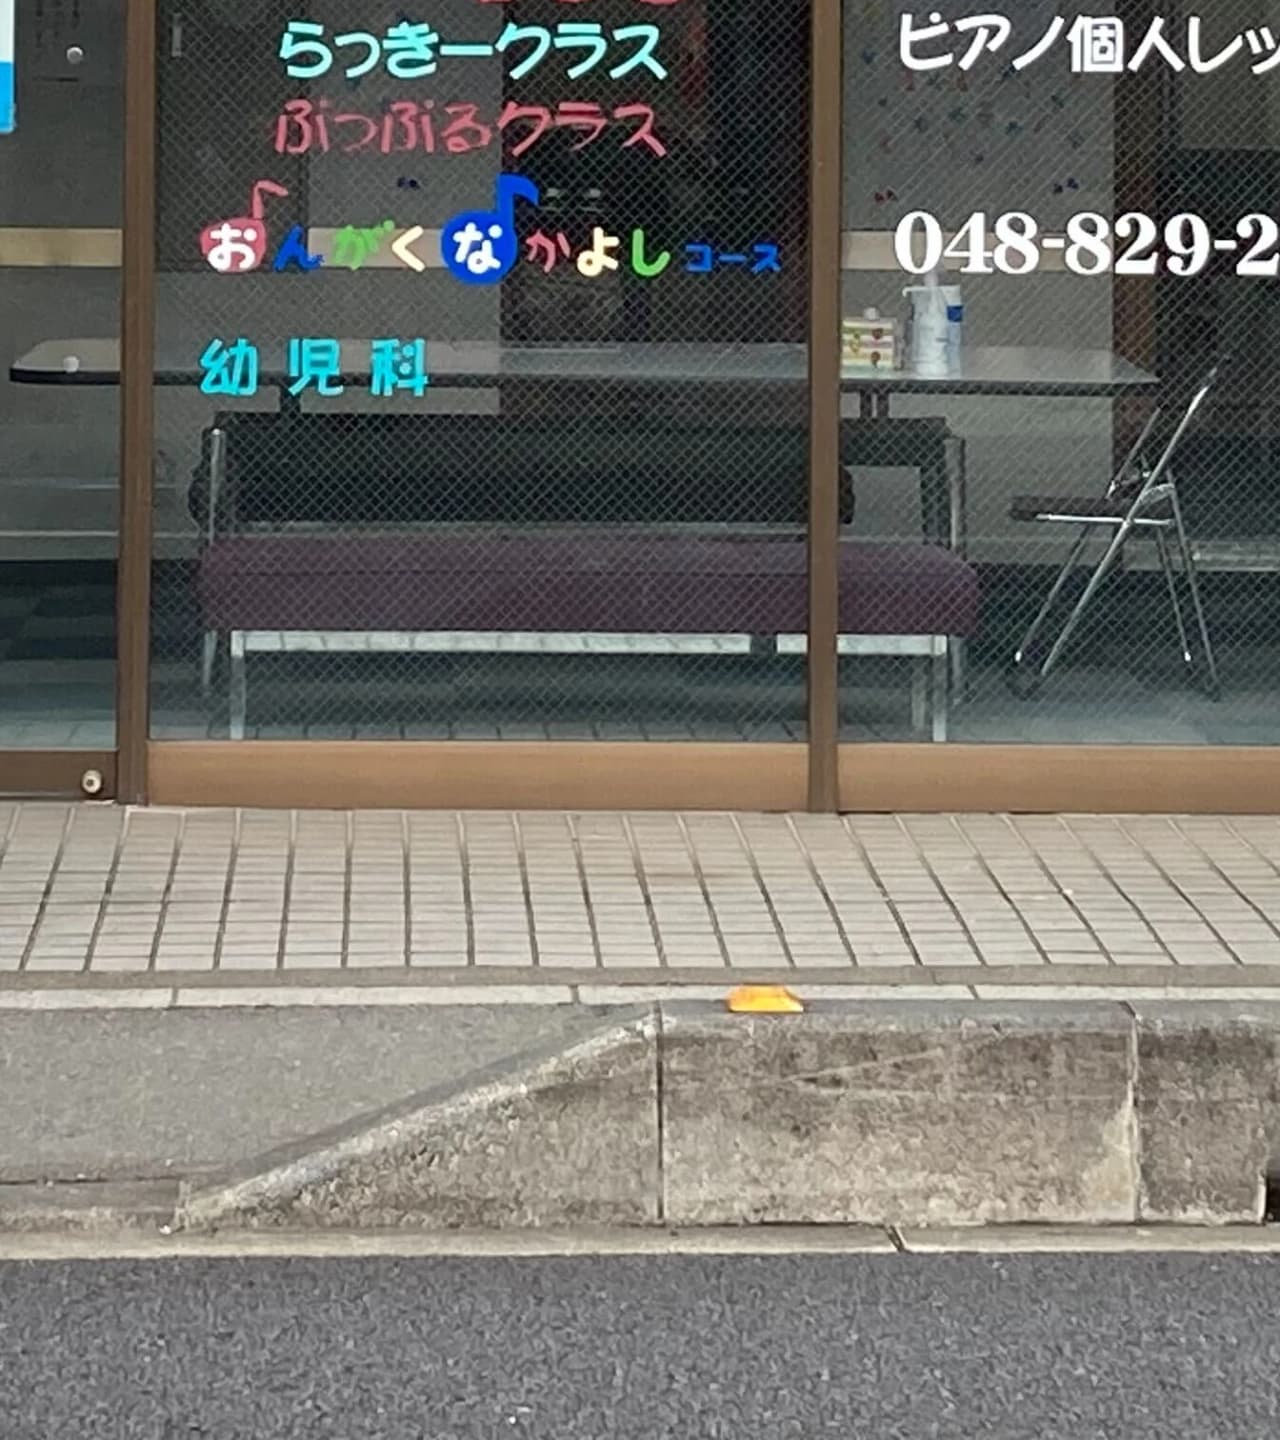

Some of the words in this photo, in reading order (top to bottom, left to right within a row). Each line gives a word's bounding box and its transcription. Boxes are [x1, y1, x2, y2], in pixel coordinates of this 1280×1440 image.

[279, 21, 668, 79] らっきークラス
[200, 338, 430, 397] 幼児科
